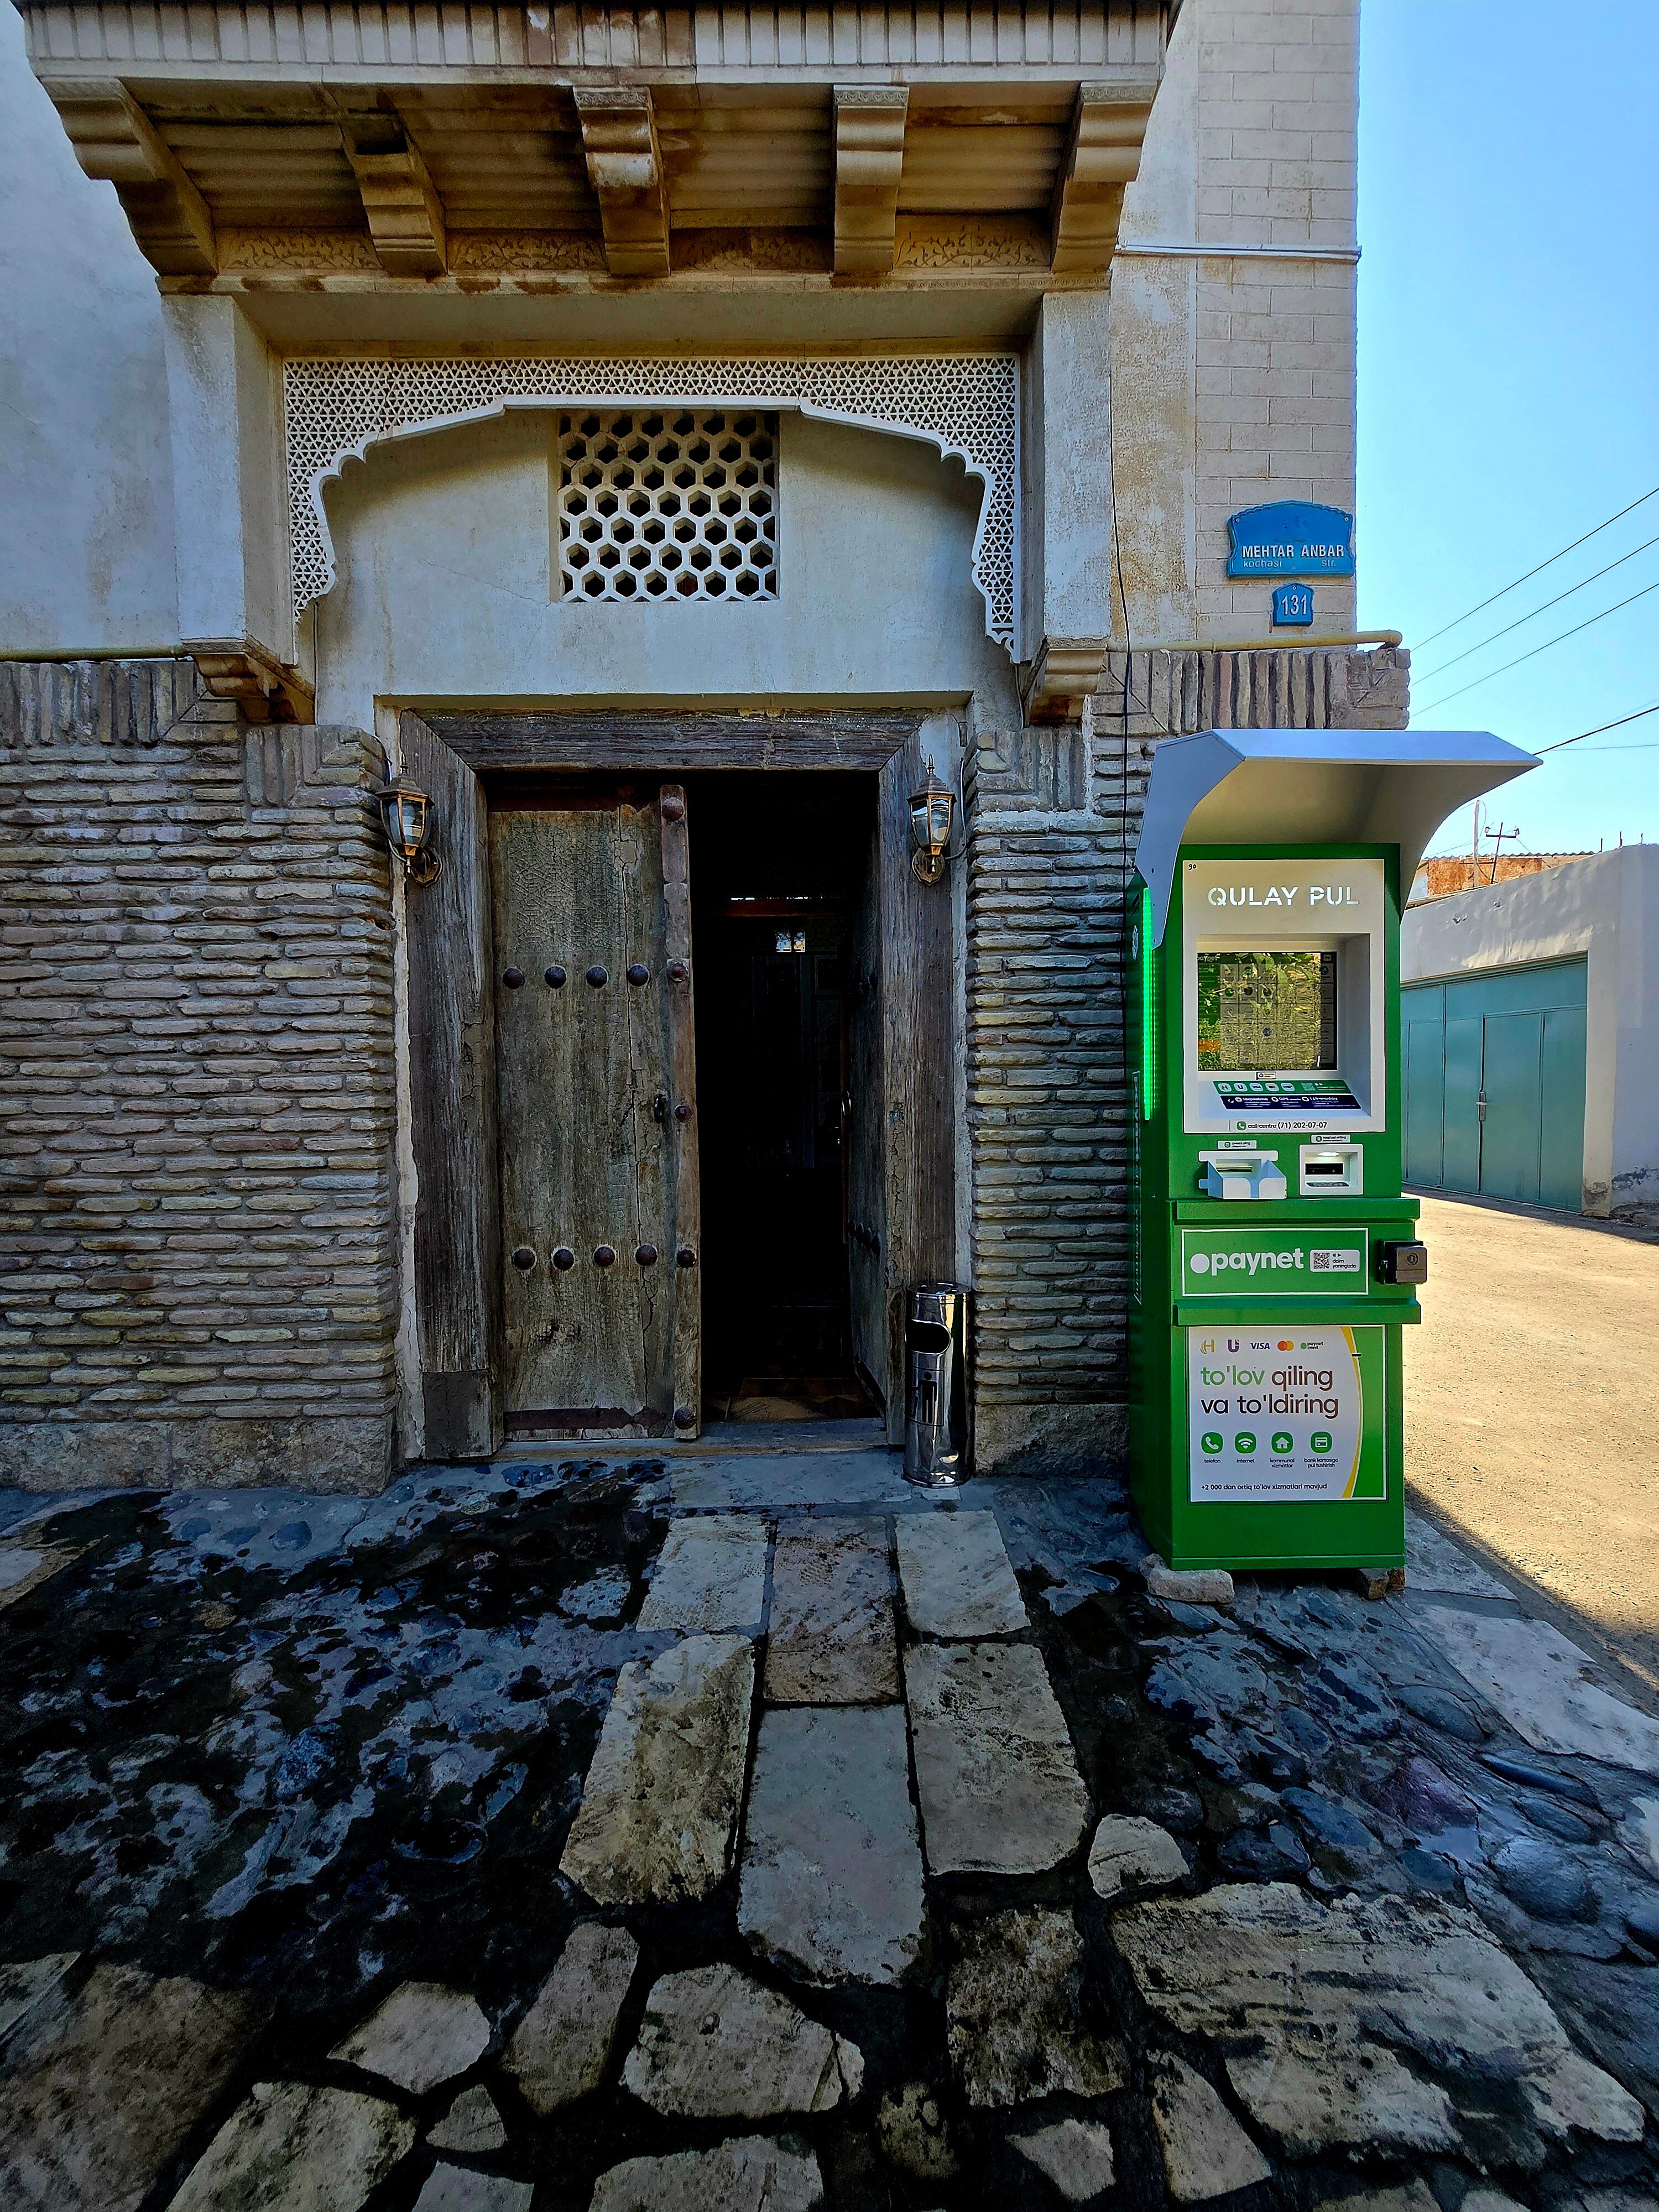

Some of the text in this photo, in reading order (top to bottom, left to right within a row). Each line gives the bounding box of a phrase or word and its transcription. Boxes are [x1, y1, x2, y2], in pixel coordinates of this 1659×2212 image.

[1242, 544, 1344, 558] MEHTAR ANBAR
[1282, 594, 1307, 615] 131
[1208, 886, 1360, 906] QULAY PUL
[1211, 1248, 1304, 1276] paynet
[1201, 1365, 1333, 1391] to'lov qiling
[1201, 1394, 1338, 1420] va to'ldiring
